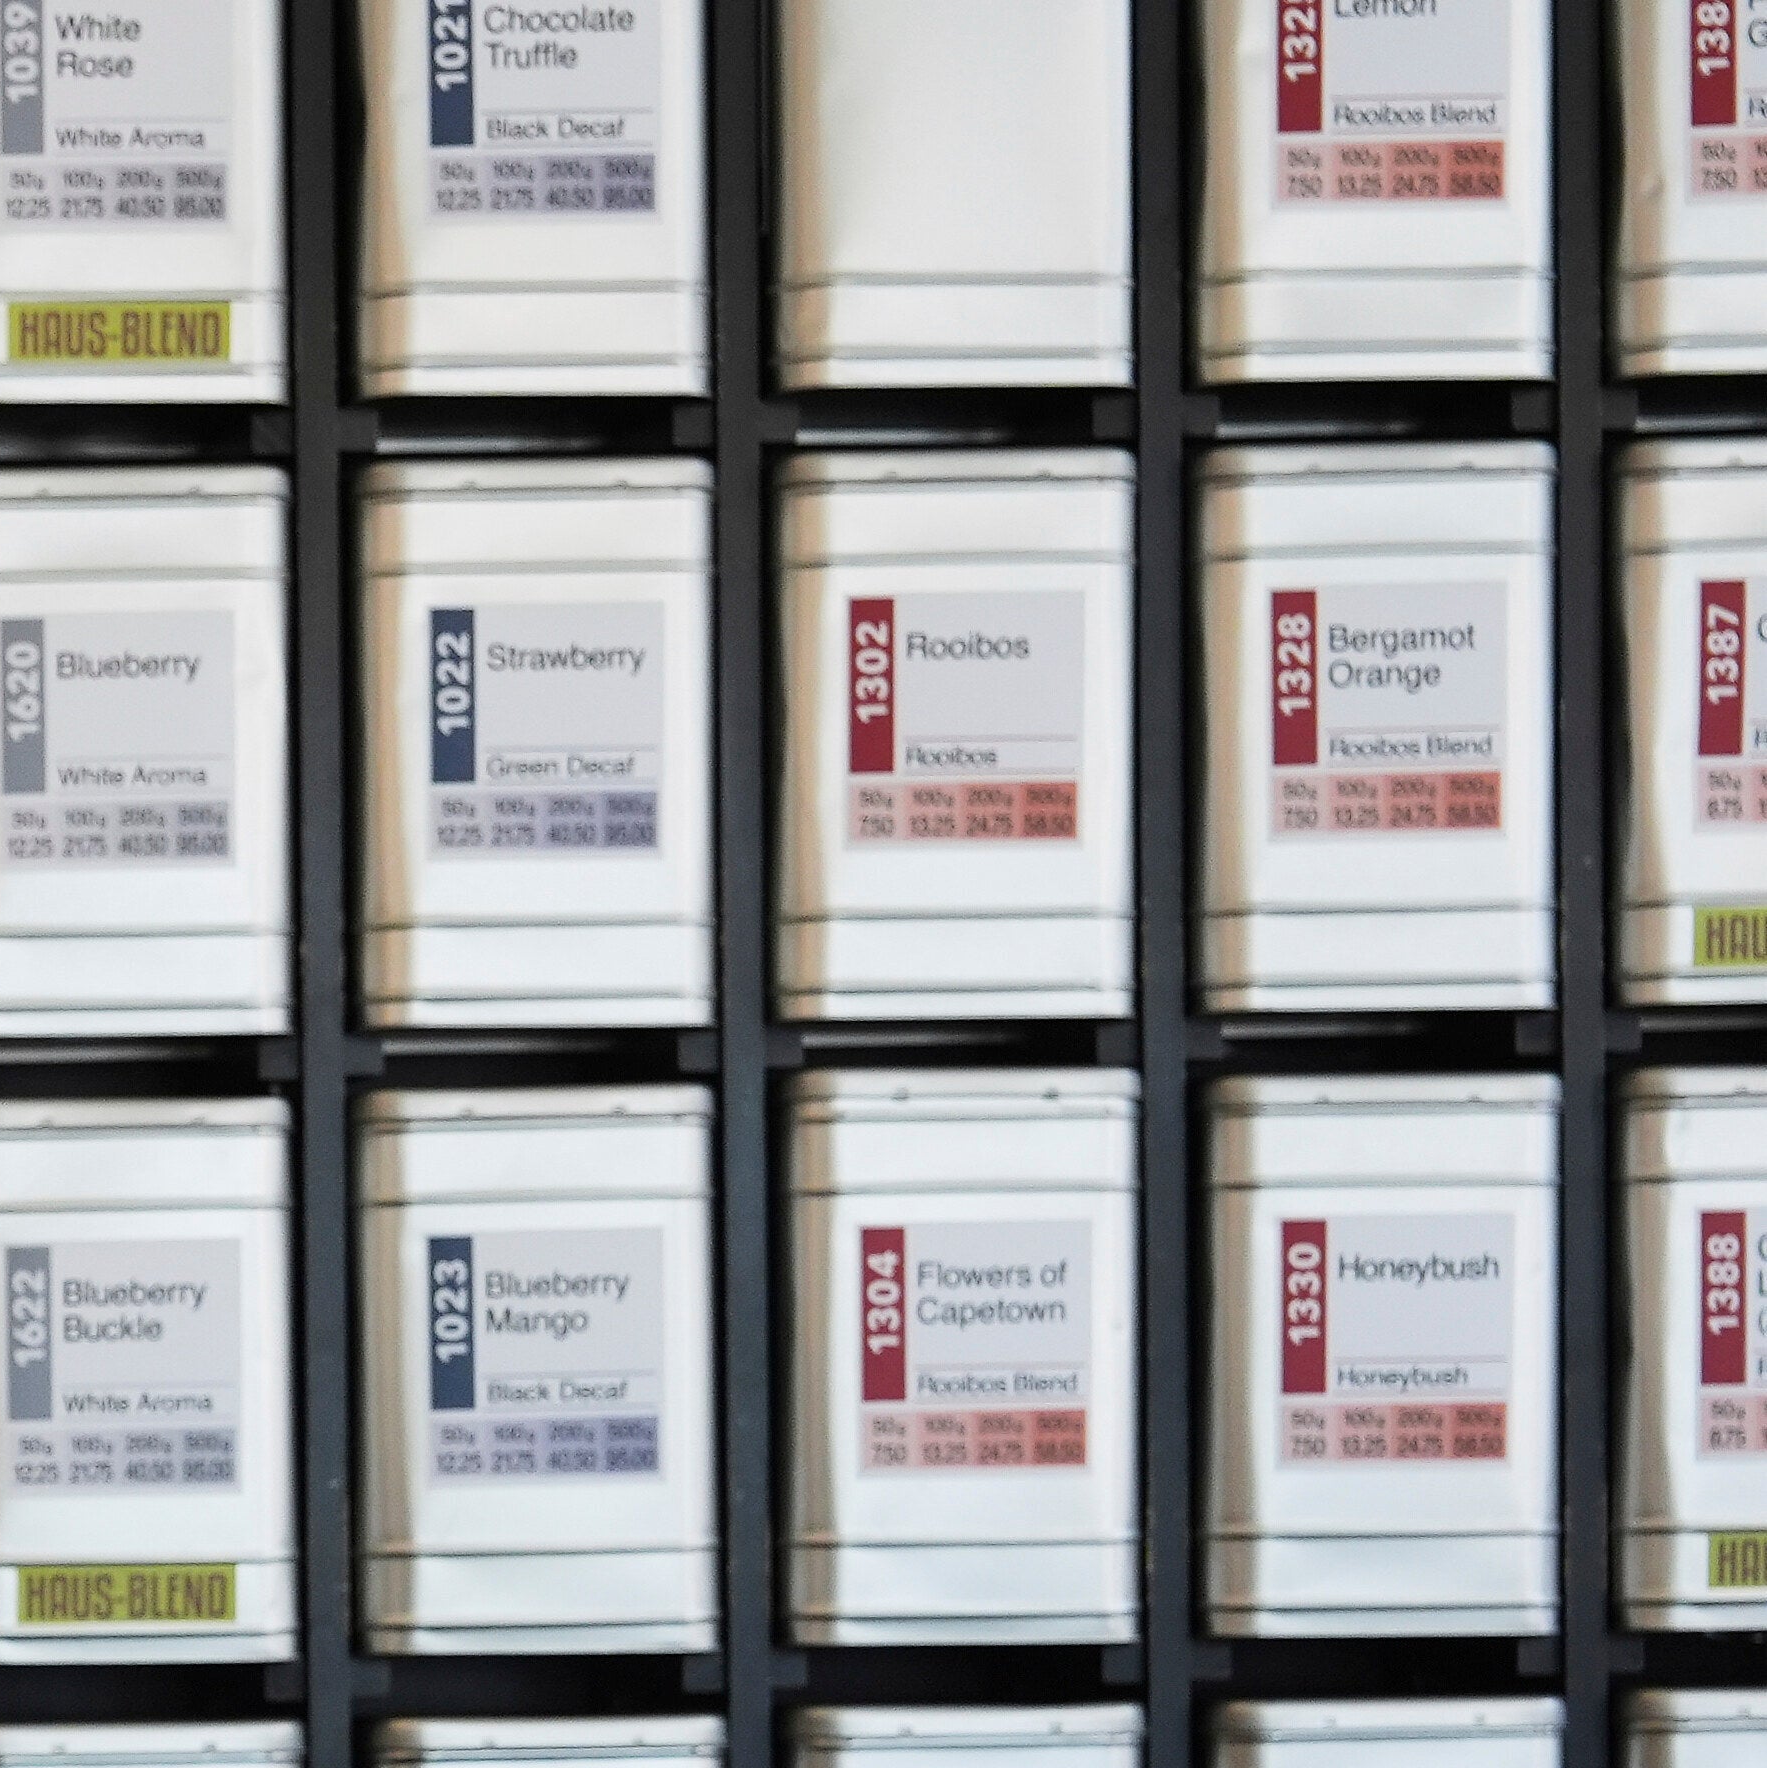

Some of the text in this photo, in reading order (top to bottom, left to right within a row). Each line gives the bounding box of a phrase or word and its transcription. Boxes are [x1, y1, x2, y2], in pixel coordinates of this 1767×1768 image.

[55, 14, 141, 42] White
[484, 4, 635, 34] Chocolate
[4, 1, 39, 103] 1039
[56, 49, 134, 78] Rose
[484, 40, 578, 70] Truffle
[19, 311, 221, 358] HAUS-BLEND
[906, 631, 1030, 660] Rooibos
[1329, 624, 1474, 659] Bergamot
[1706, 603, 1740, 705] 1387
[56, 651, 201, 682] Blueberry
[487, 642, 646, 674] Strawberry
[1277, 614, 1312, 716] 1328
[435, 632, 471, 735] 1022
[1328, 659, 1441, 695] Orange
[905, 745, 998, 768] Rooibos
[58, 765, 208, 787] White Aroma
[917, 1259, 1067, 1289] Flowers of
[1338, 1252, 1499, 1286] Honeybush
[63, 1279, 207, 1311] Blueberry
[485, 1271, 630, 1301] Blueberry
[867, 1251, 900, 1353] 1304
[12, 1270, 46, 1366] 1622
[63, 1314, 164, 1343] Buckle
[485, 1307, 589, 1342] Mango
[916, 1296, 1066, 1329] Capetown
[1337, 1366, 1468, 1394] Honeybush
[26, 1573, 227, 1620] HAUS-BLEND
